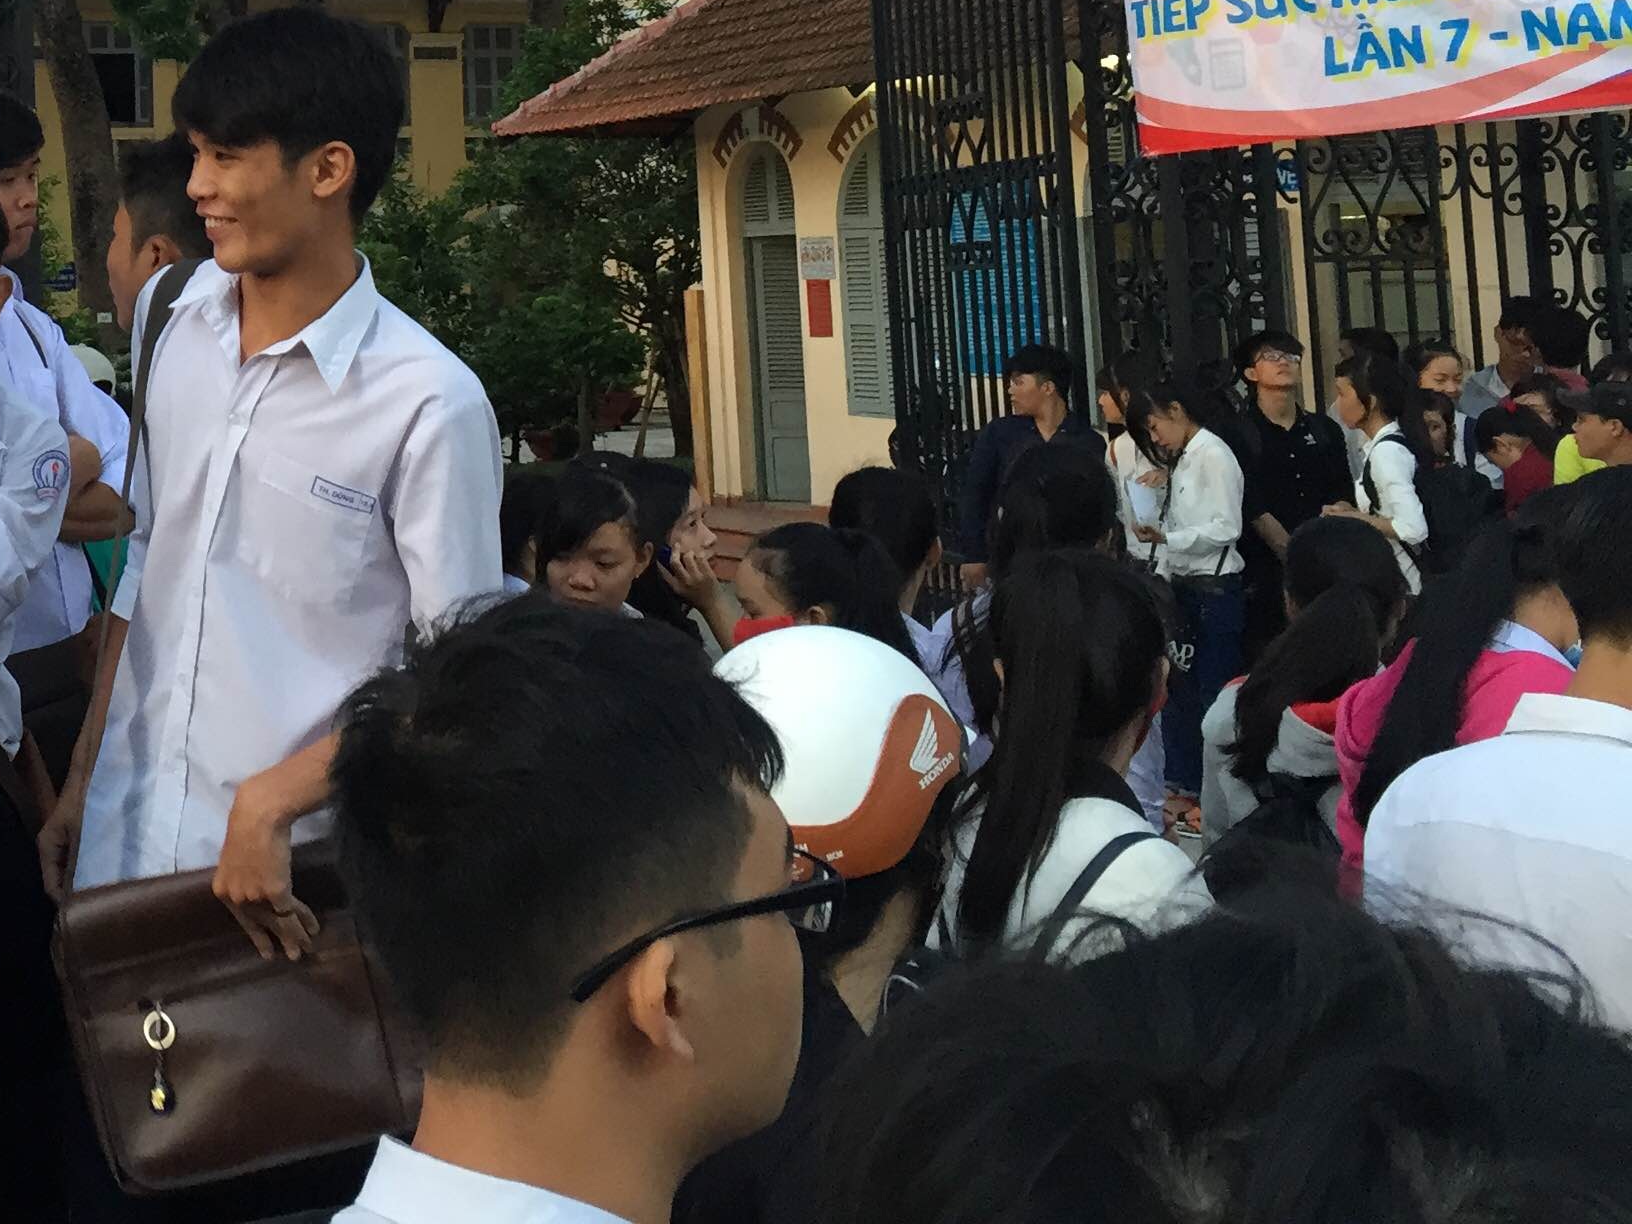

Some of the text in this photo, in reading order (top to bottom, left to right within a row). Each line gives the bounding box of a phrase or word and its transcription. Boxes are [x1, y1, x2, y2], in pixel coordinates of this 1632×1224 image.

[1324, 12, 1427, 76] LẦN
[1440, 17, 1470, 62] 7
[918, 752, 955, 790] HONDA
